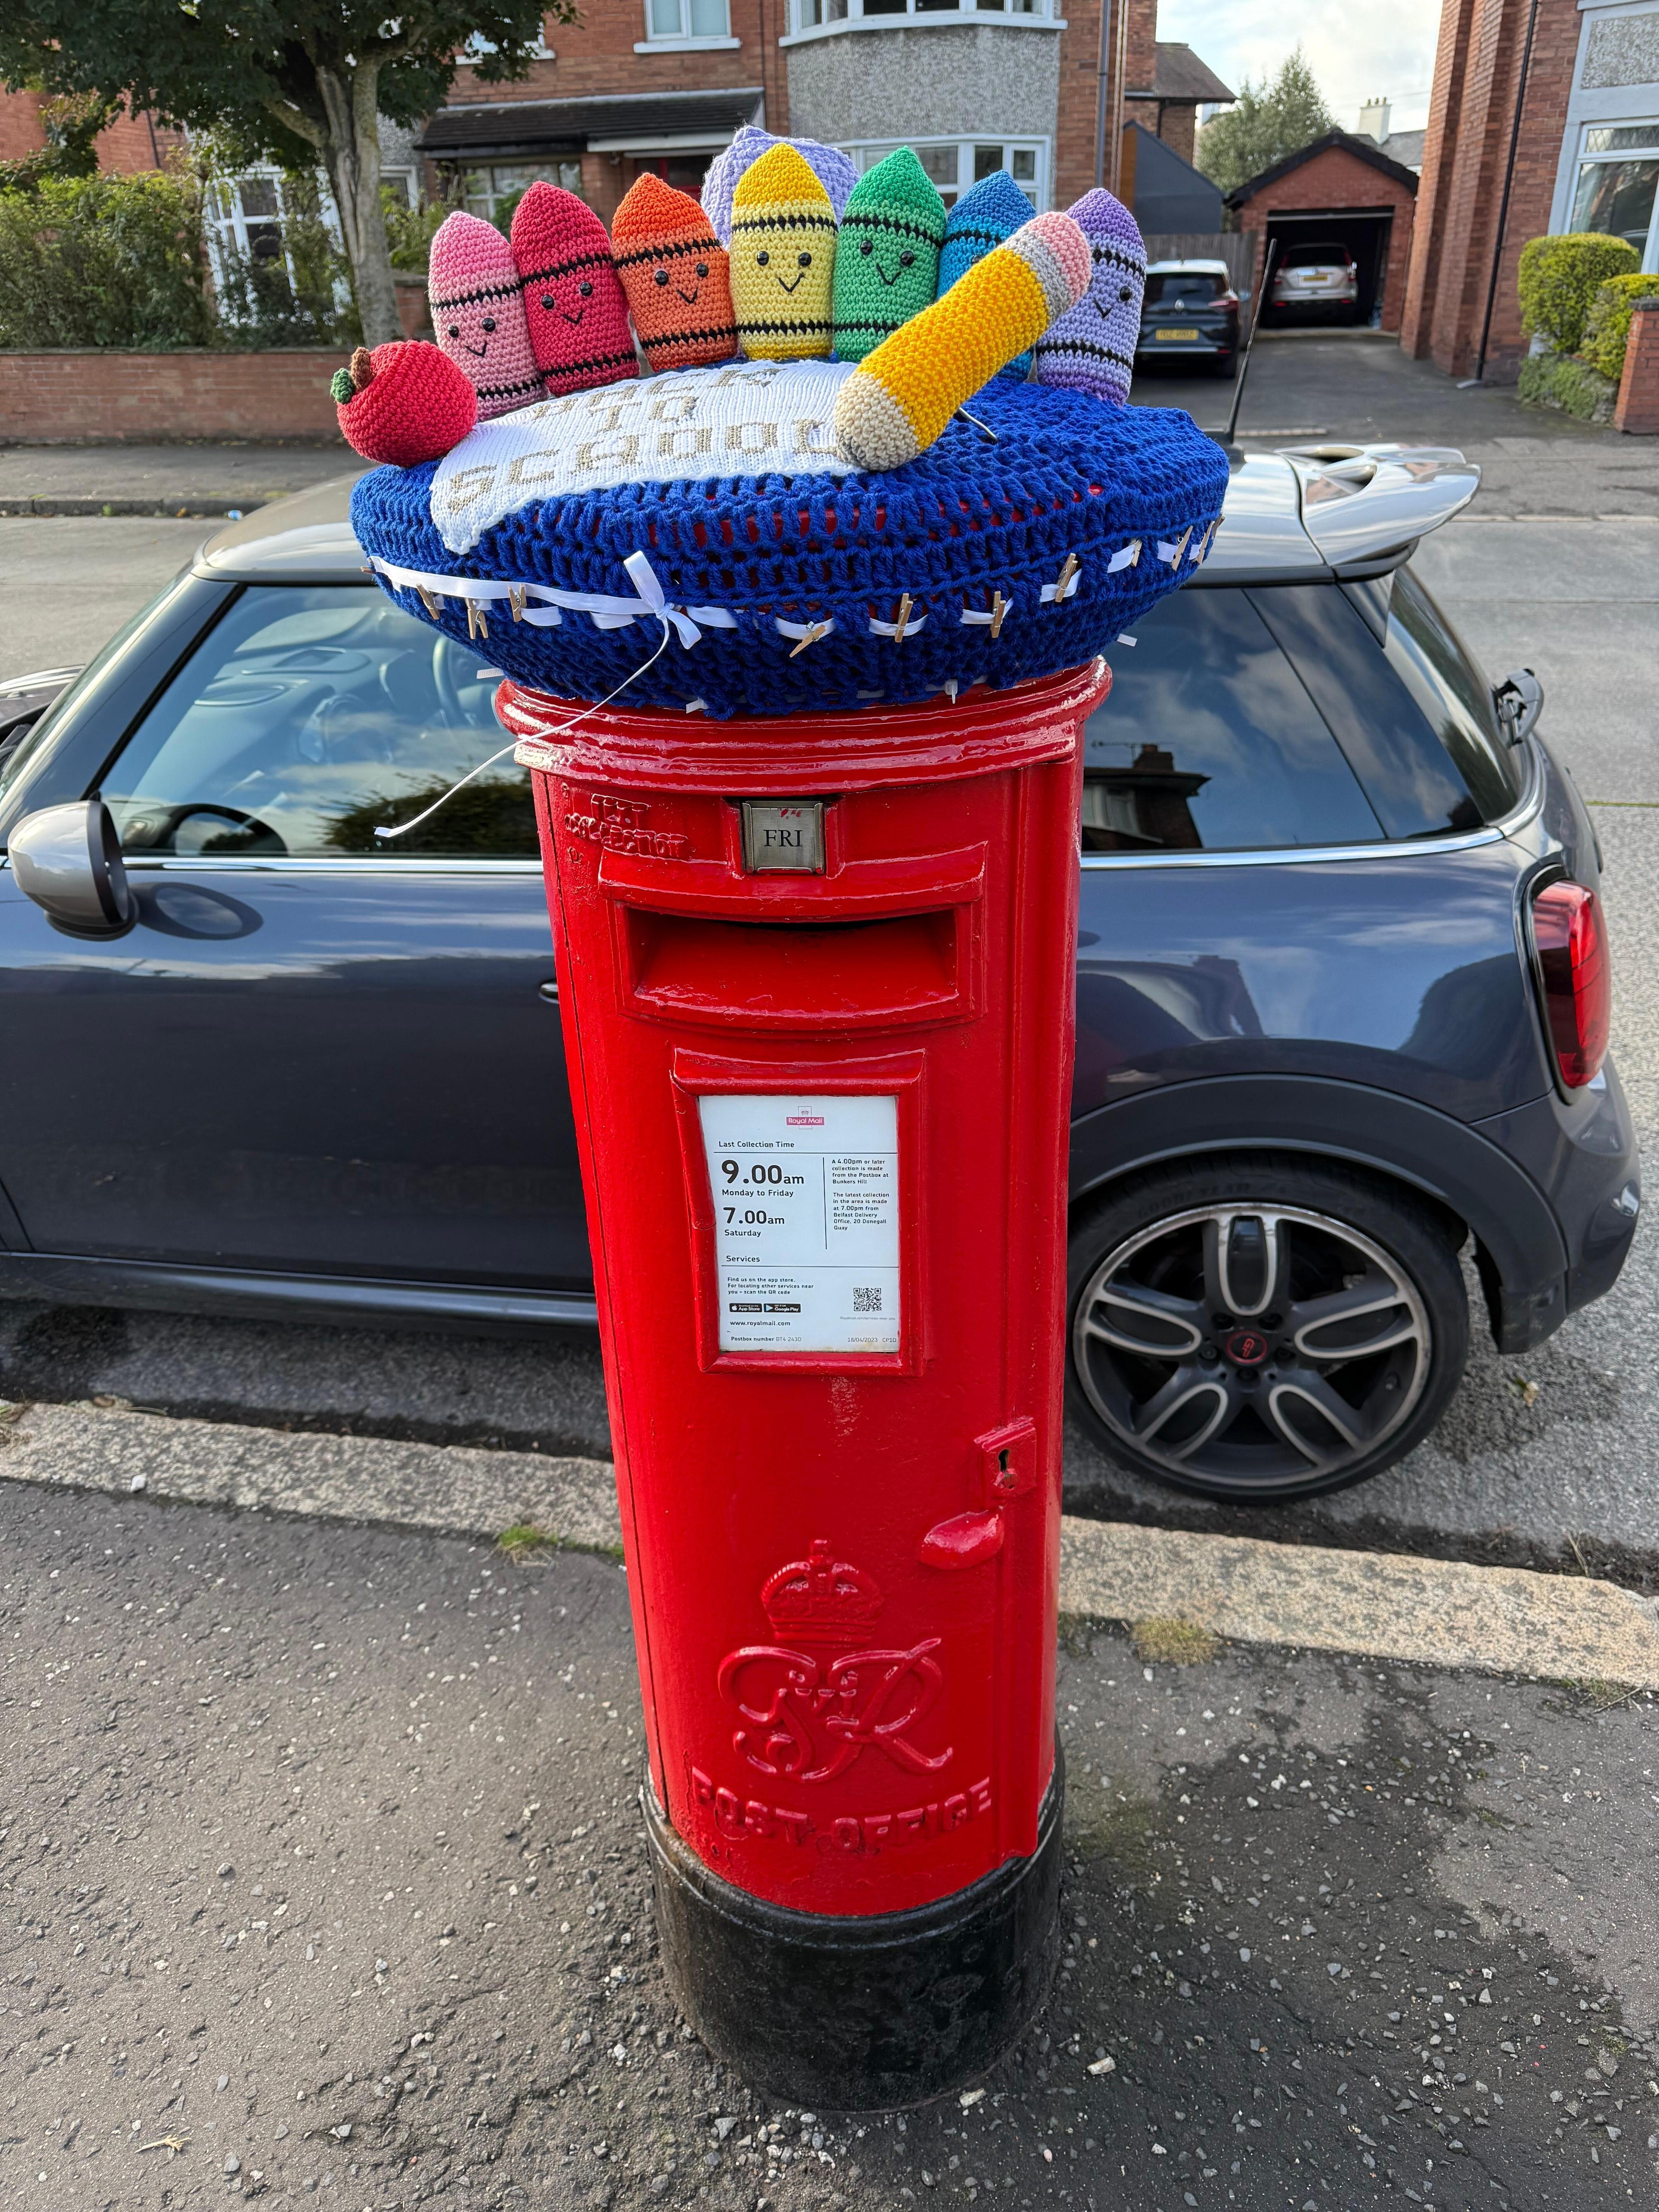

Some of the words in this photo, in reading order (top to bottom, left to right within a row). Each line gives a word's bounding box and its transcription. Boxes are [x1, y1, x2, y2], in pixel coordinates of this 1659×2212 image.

[588, 396, 697, 433] TO
[447, 418, 839, 514] SCHOOL
[763, 830, 802, 847] FRI
[722, 1160, 804, 1184] 9.00am
[723, 1207, 784, 1224] 7.00am
[692, 1766, 809, 1845] POST
[831, 1776, 992, 1852] OFFICE
